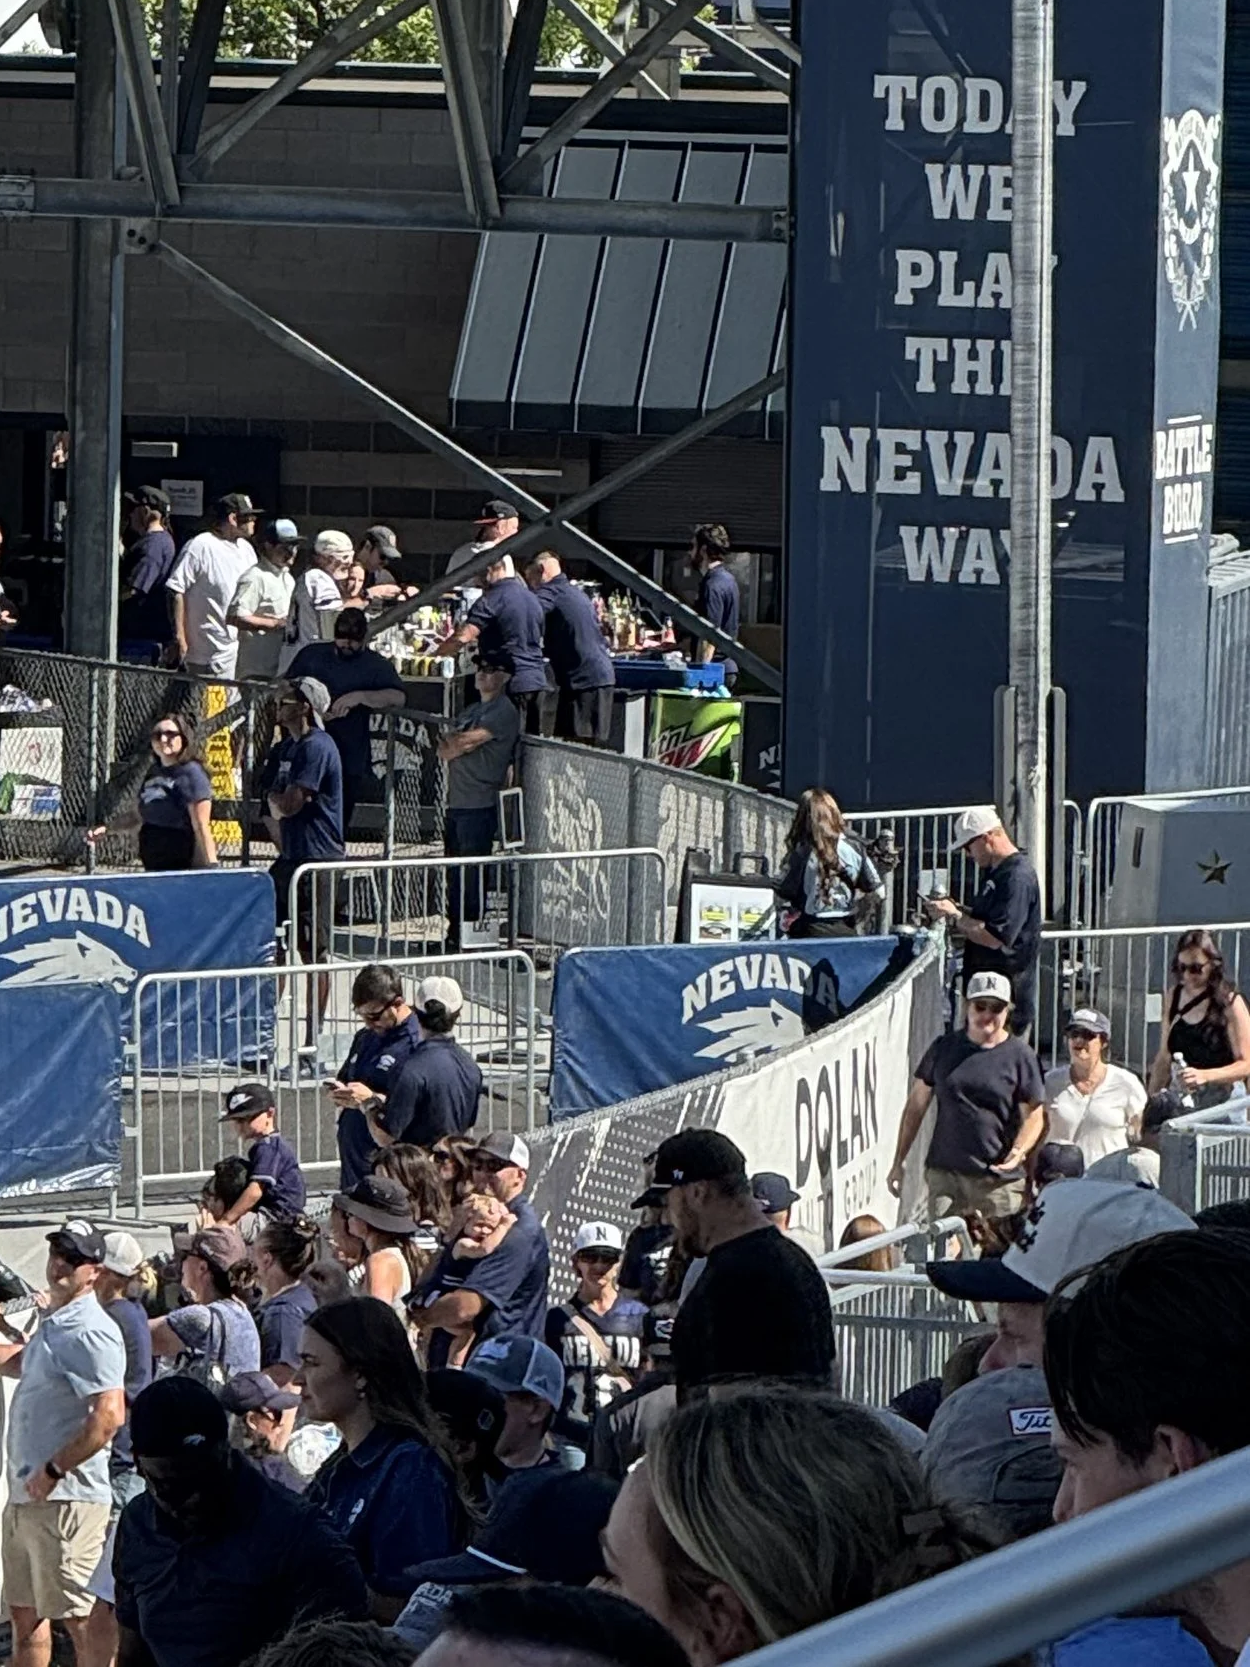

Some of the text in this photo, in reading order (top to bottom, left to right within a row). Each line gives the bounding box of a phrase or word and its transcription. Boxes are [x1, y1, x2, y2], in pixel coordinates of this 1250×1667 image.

[873, 74, 1087, 136] TODY
[894, 249, 1058, 308] PLA
[1155, 424, 1213, 479] BATTLE
[899, 525, 1013, 584] WA
[681, 953, 840, 1025] NEVADA
[796, 1036, 879, 1190] DOLAN
[595, 1226, 607, 1242] N
